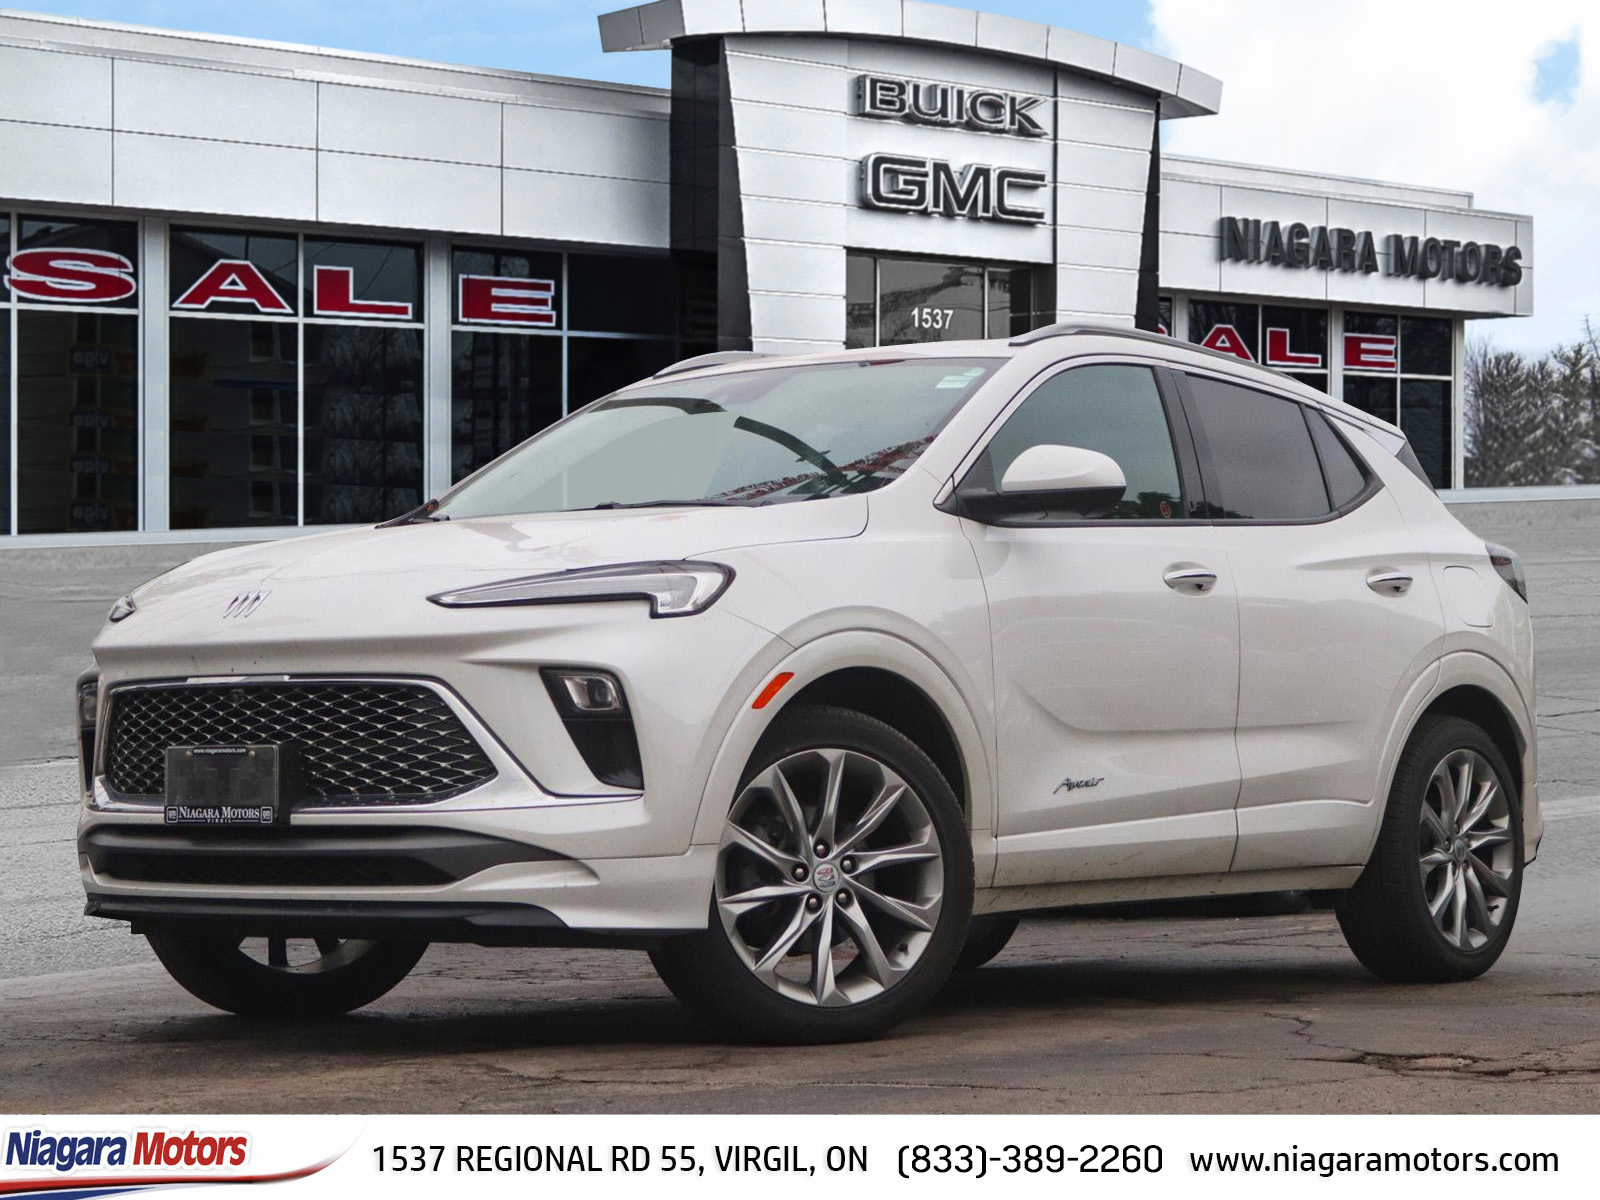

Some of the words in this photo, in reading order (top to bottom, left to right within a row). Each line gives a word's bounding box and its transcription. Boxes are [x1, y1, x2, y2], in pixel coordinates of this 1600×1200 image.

[857, 74, 1048, 137] BUICK
[861, 152, 1047, 224] GMC
[1218, 216, 1379, 275] NIAGARA
[1386, 234, 1523, 287] MOTORS
[4, 247, 556, 327] SALE
[911, 307, 953, 329] 1537
[1158, 323, 1397, 371] ALE
